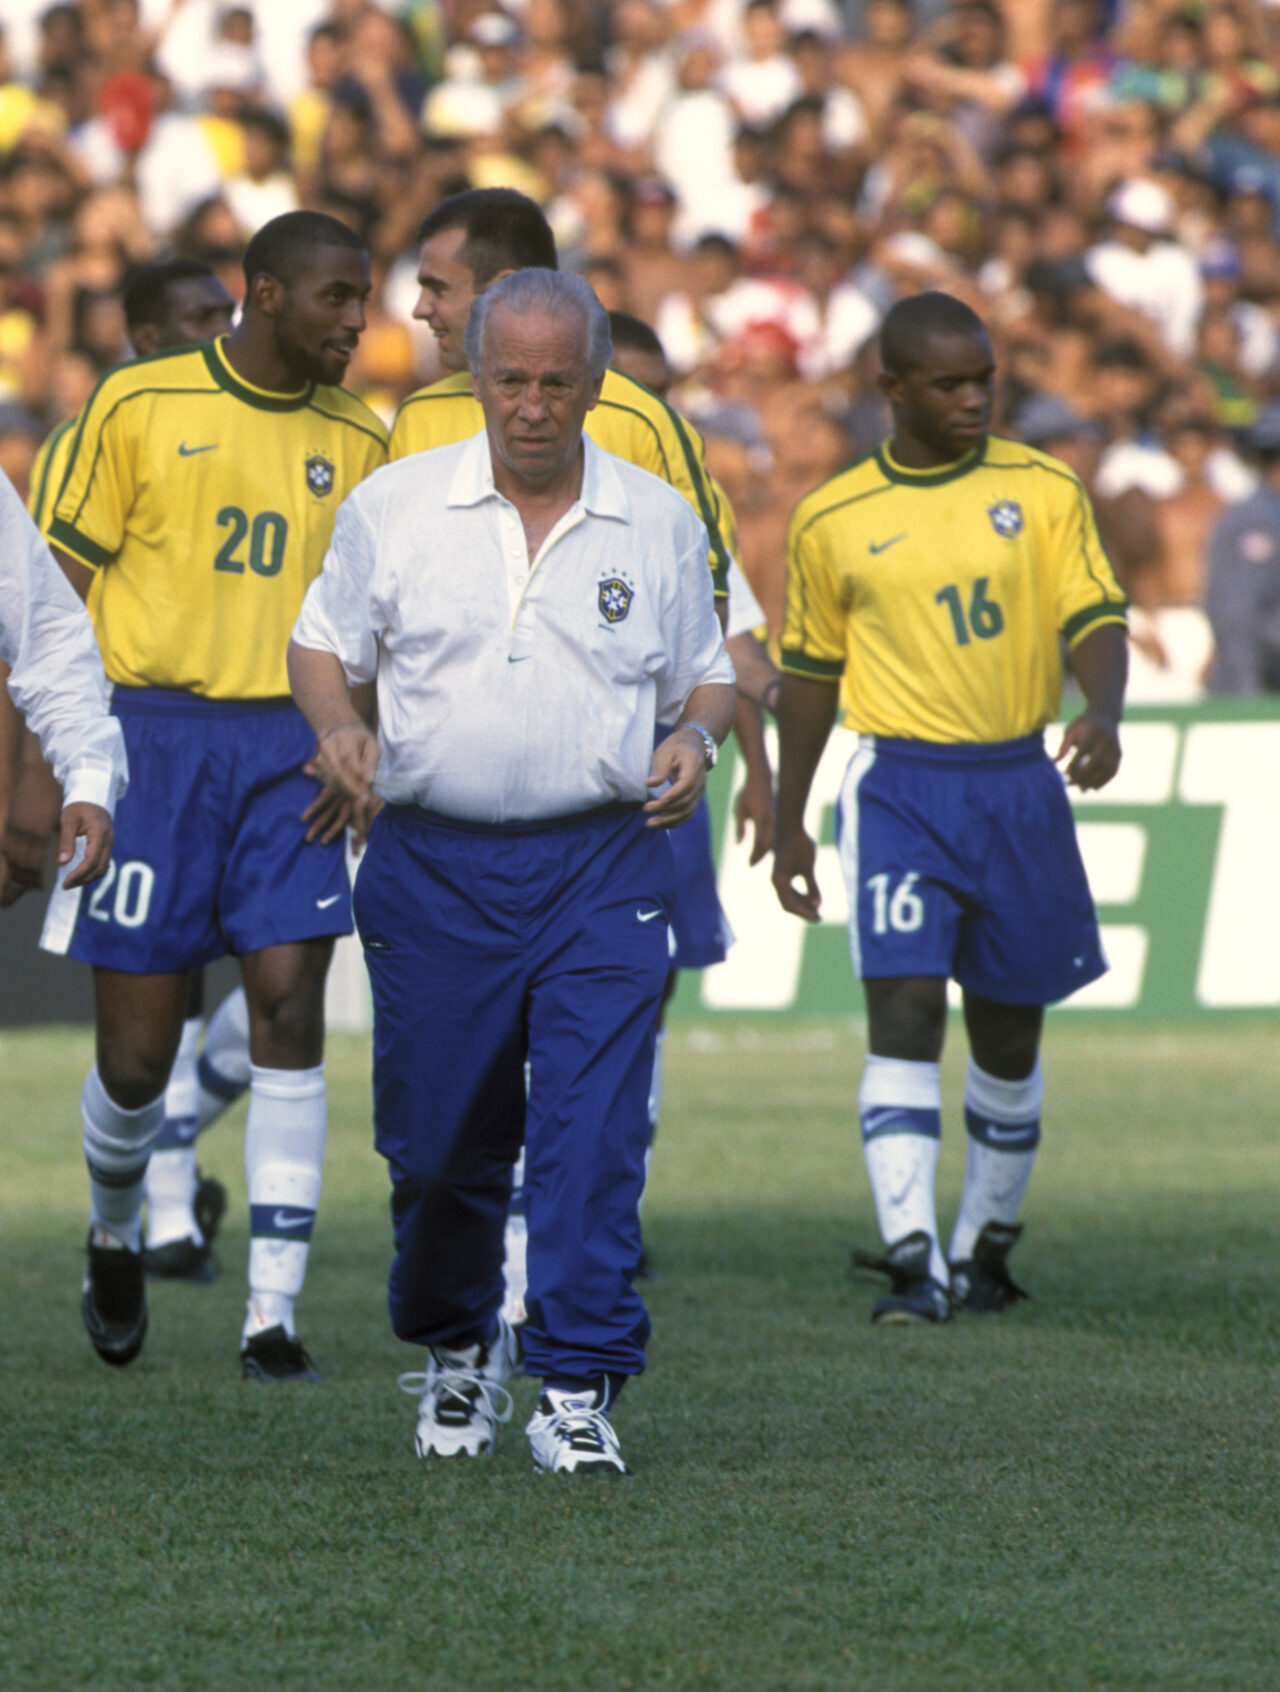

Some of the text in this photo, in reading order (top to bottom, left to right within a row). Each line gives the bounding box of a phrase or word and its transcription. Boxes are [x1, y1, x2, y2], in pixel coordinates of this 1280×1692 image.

[214, 506, 288, 577] 20
[935, 576, 1005, 646] 16
[88, 857, 155, 928] 20
[866, 872, 924, 935] 16
